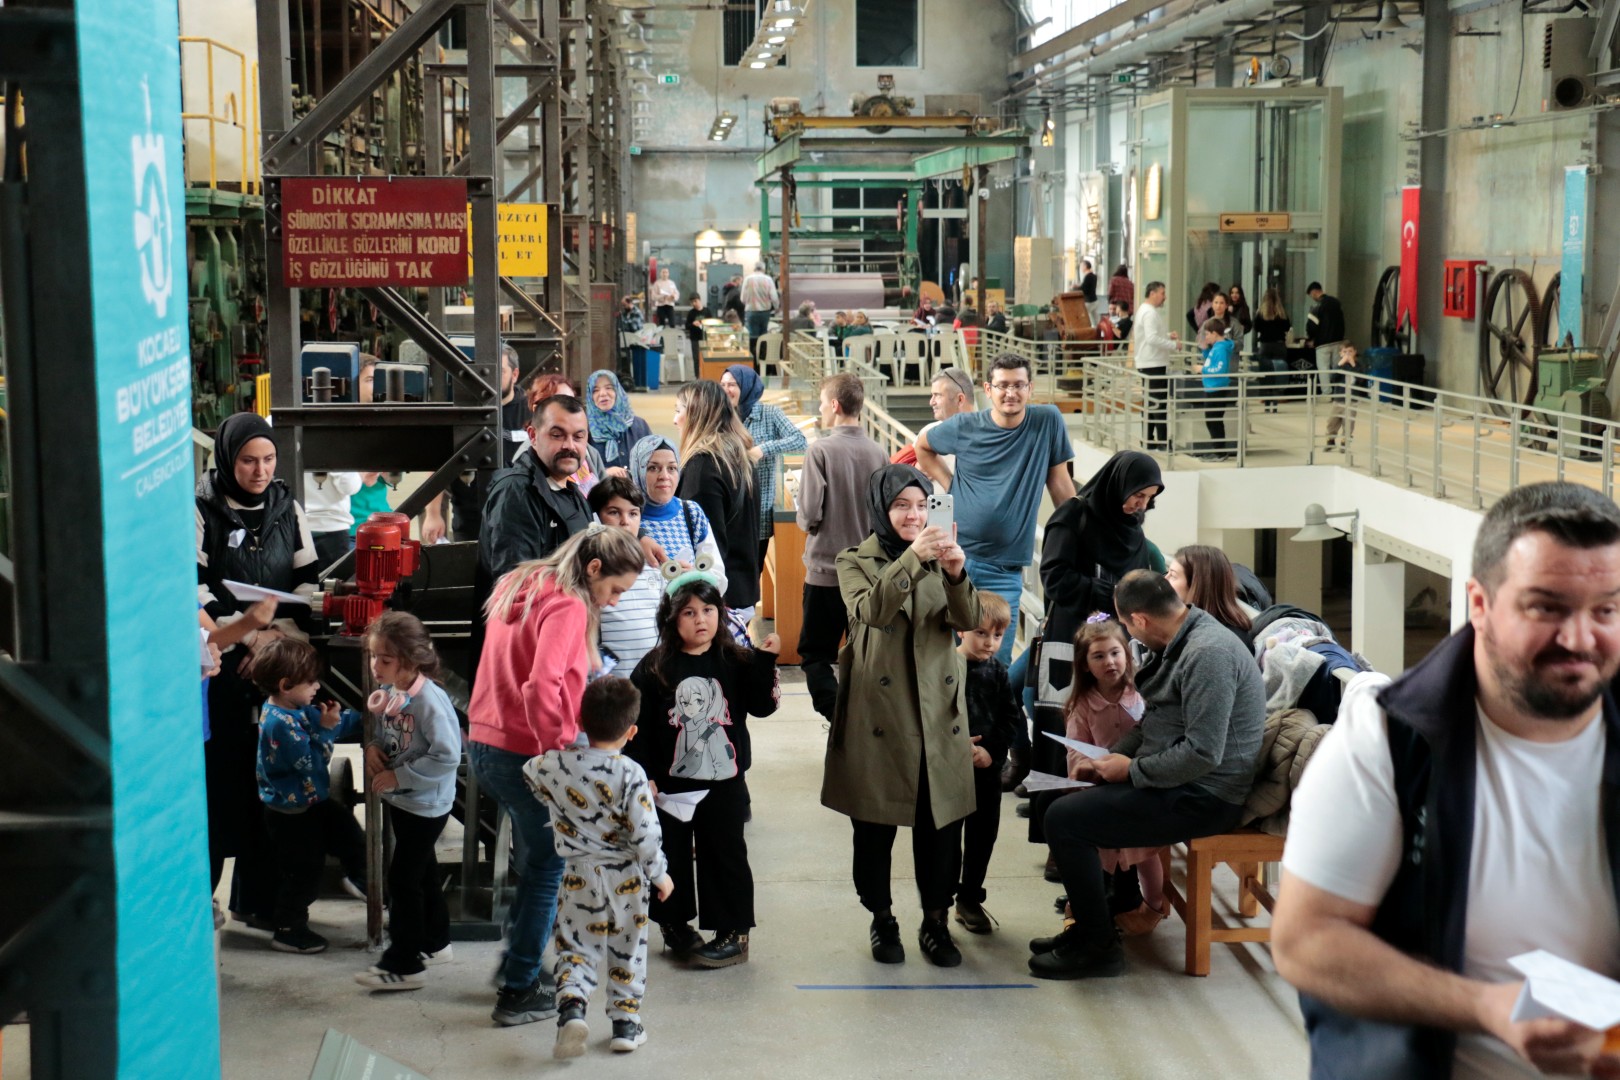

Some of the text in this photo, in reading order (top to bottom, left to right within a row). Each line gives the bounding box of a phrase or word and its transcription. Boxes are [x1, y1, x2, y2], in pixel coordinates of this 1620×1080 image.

[312, 184, 378, 205] DİKKAT
[351, 212, 432, 232] SIÇRAMASINA
[434, 212, 467, 232] KARŞI
[498, 211, 538, 223] ÜZEYİ
[288, 233, 461, 254] ÖZELLİKLE GÖZLERİNİ KORU
[516, 250, 533, 260] ET
[289, 258, 433, 282] İŞ GÖZLÜĞÜNÜ TAK
